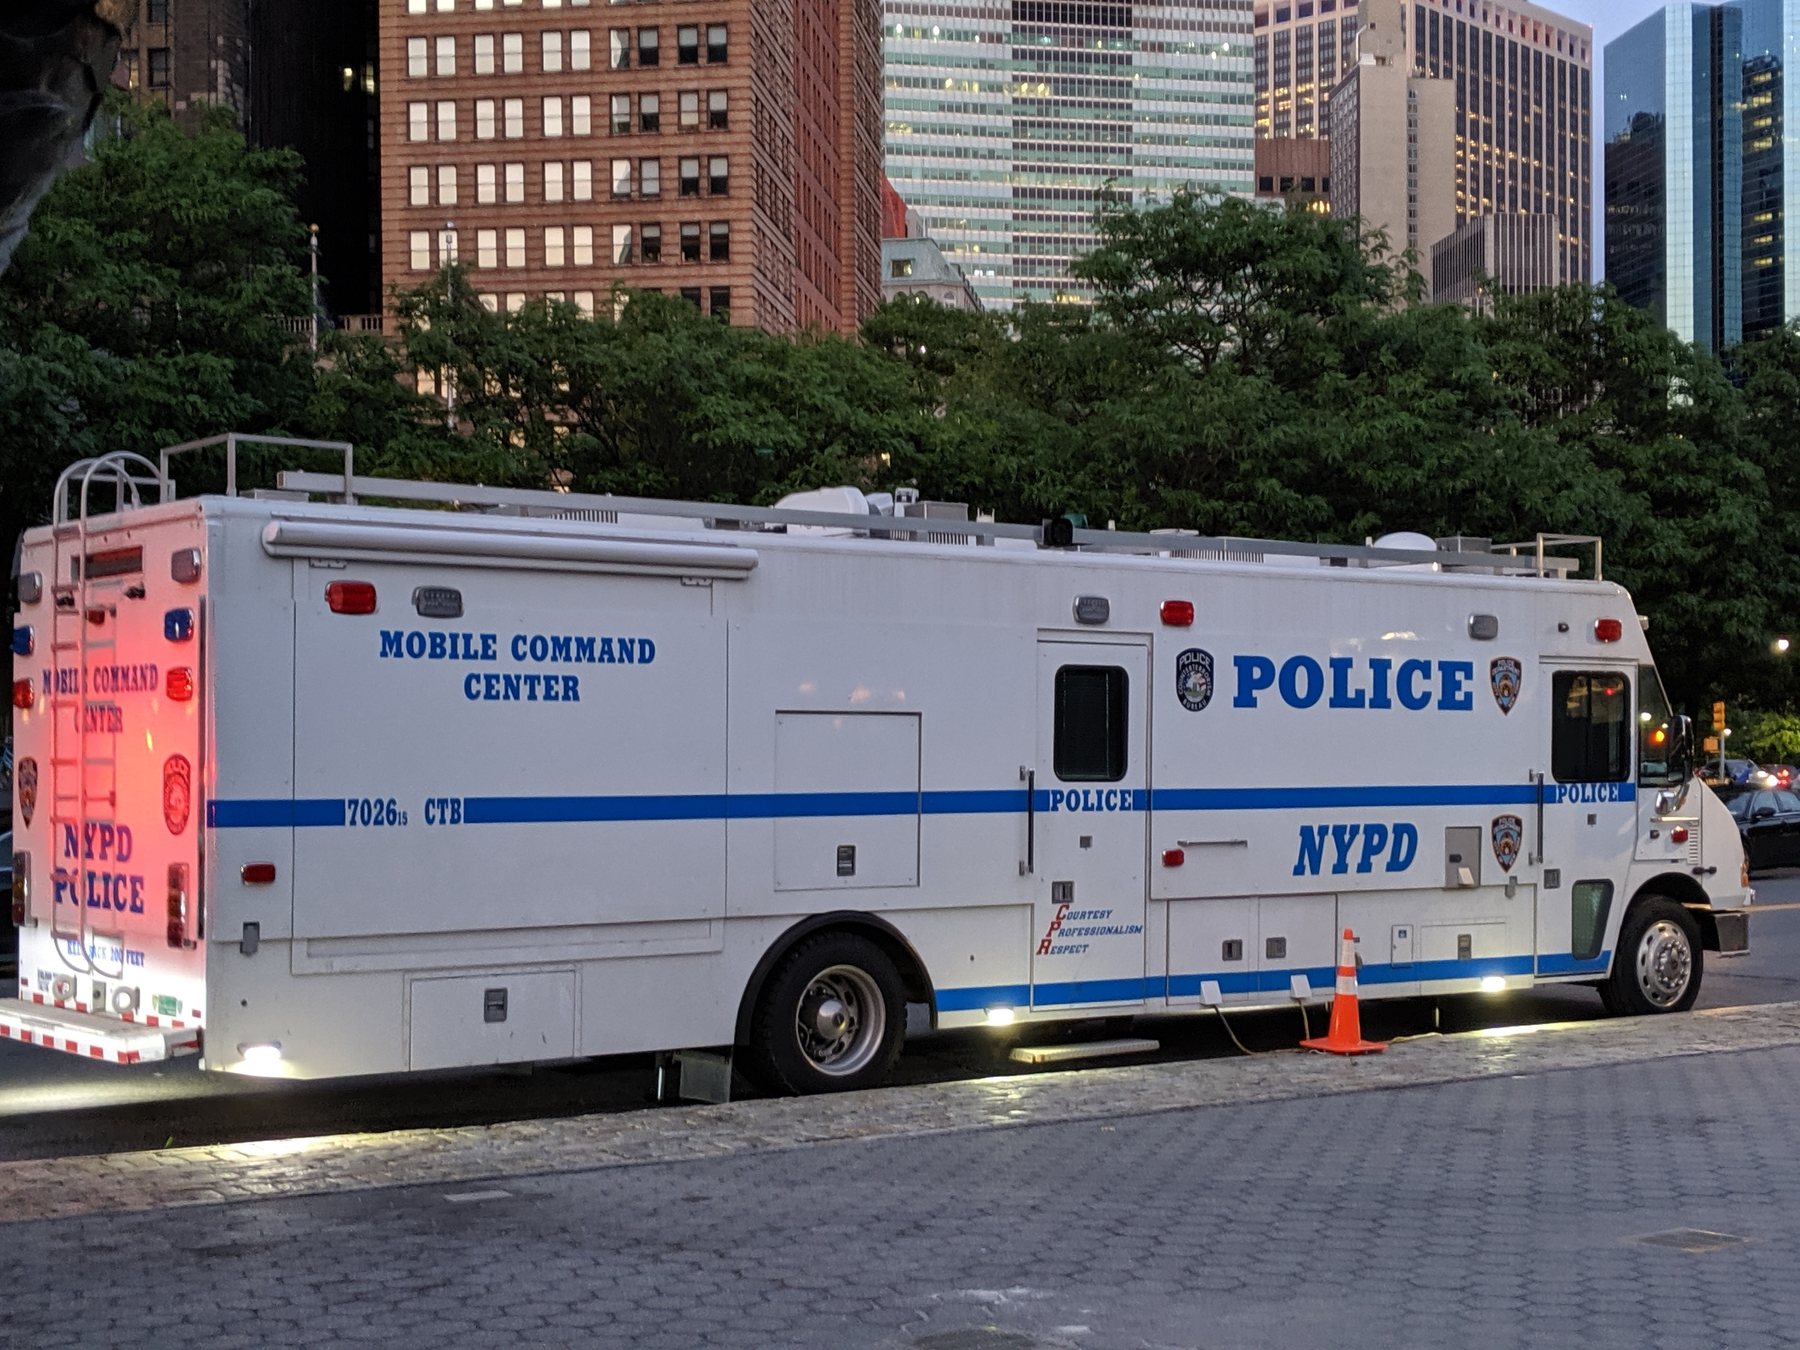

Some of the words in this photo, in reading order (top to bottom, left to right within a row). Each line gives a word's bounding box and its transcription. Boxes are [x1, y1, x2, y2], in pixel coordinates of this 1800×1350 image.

[380, 630, 497, 660] MOBILE
[511, 634, 656, 664] COMMAND
[93, 663, 158, 693] COMMAND
[464, 673, 580, 701] CENTER
[1233, 655, 1474, 711] POLICE
[1050, 789, 1132, 812] POLICE
[1557, 783, 1618, 803] POLICE
[424, 798, 462, 825] CTB
[64, 822, 132, 862] NYPD
[1293, 823, 1418, 876] NYPD
[1056, 903, 1113, 921] COURTESY
[1046, 920, 1143, 937] PROFESSIONALISM
[1036, 938, 1089, 955] RESPECT
